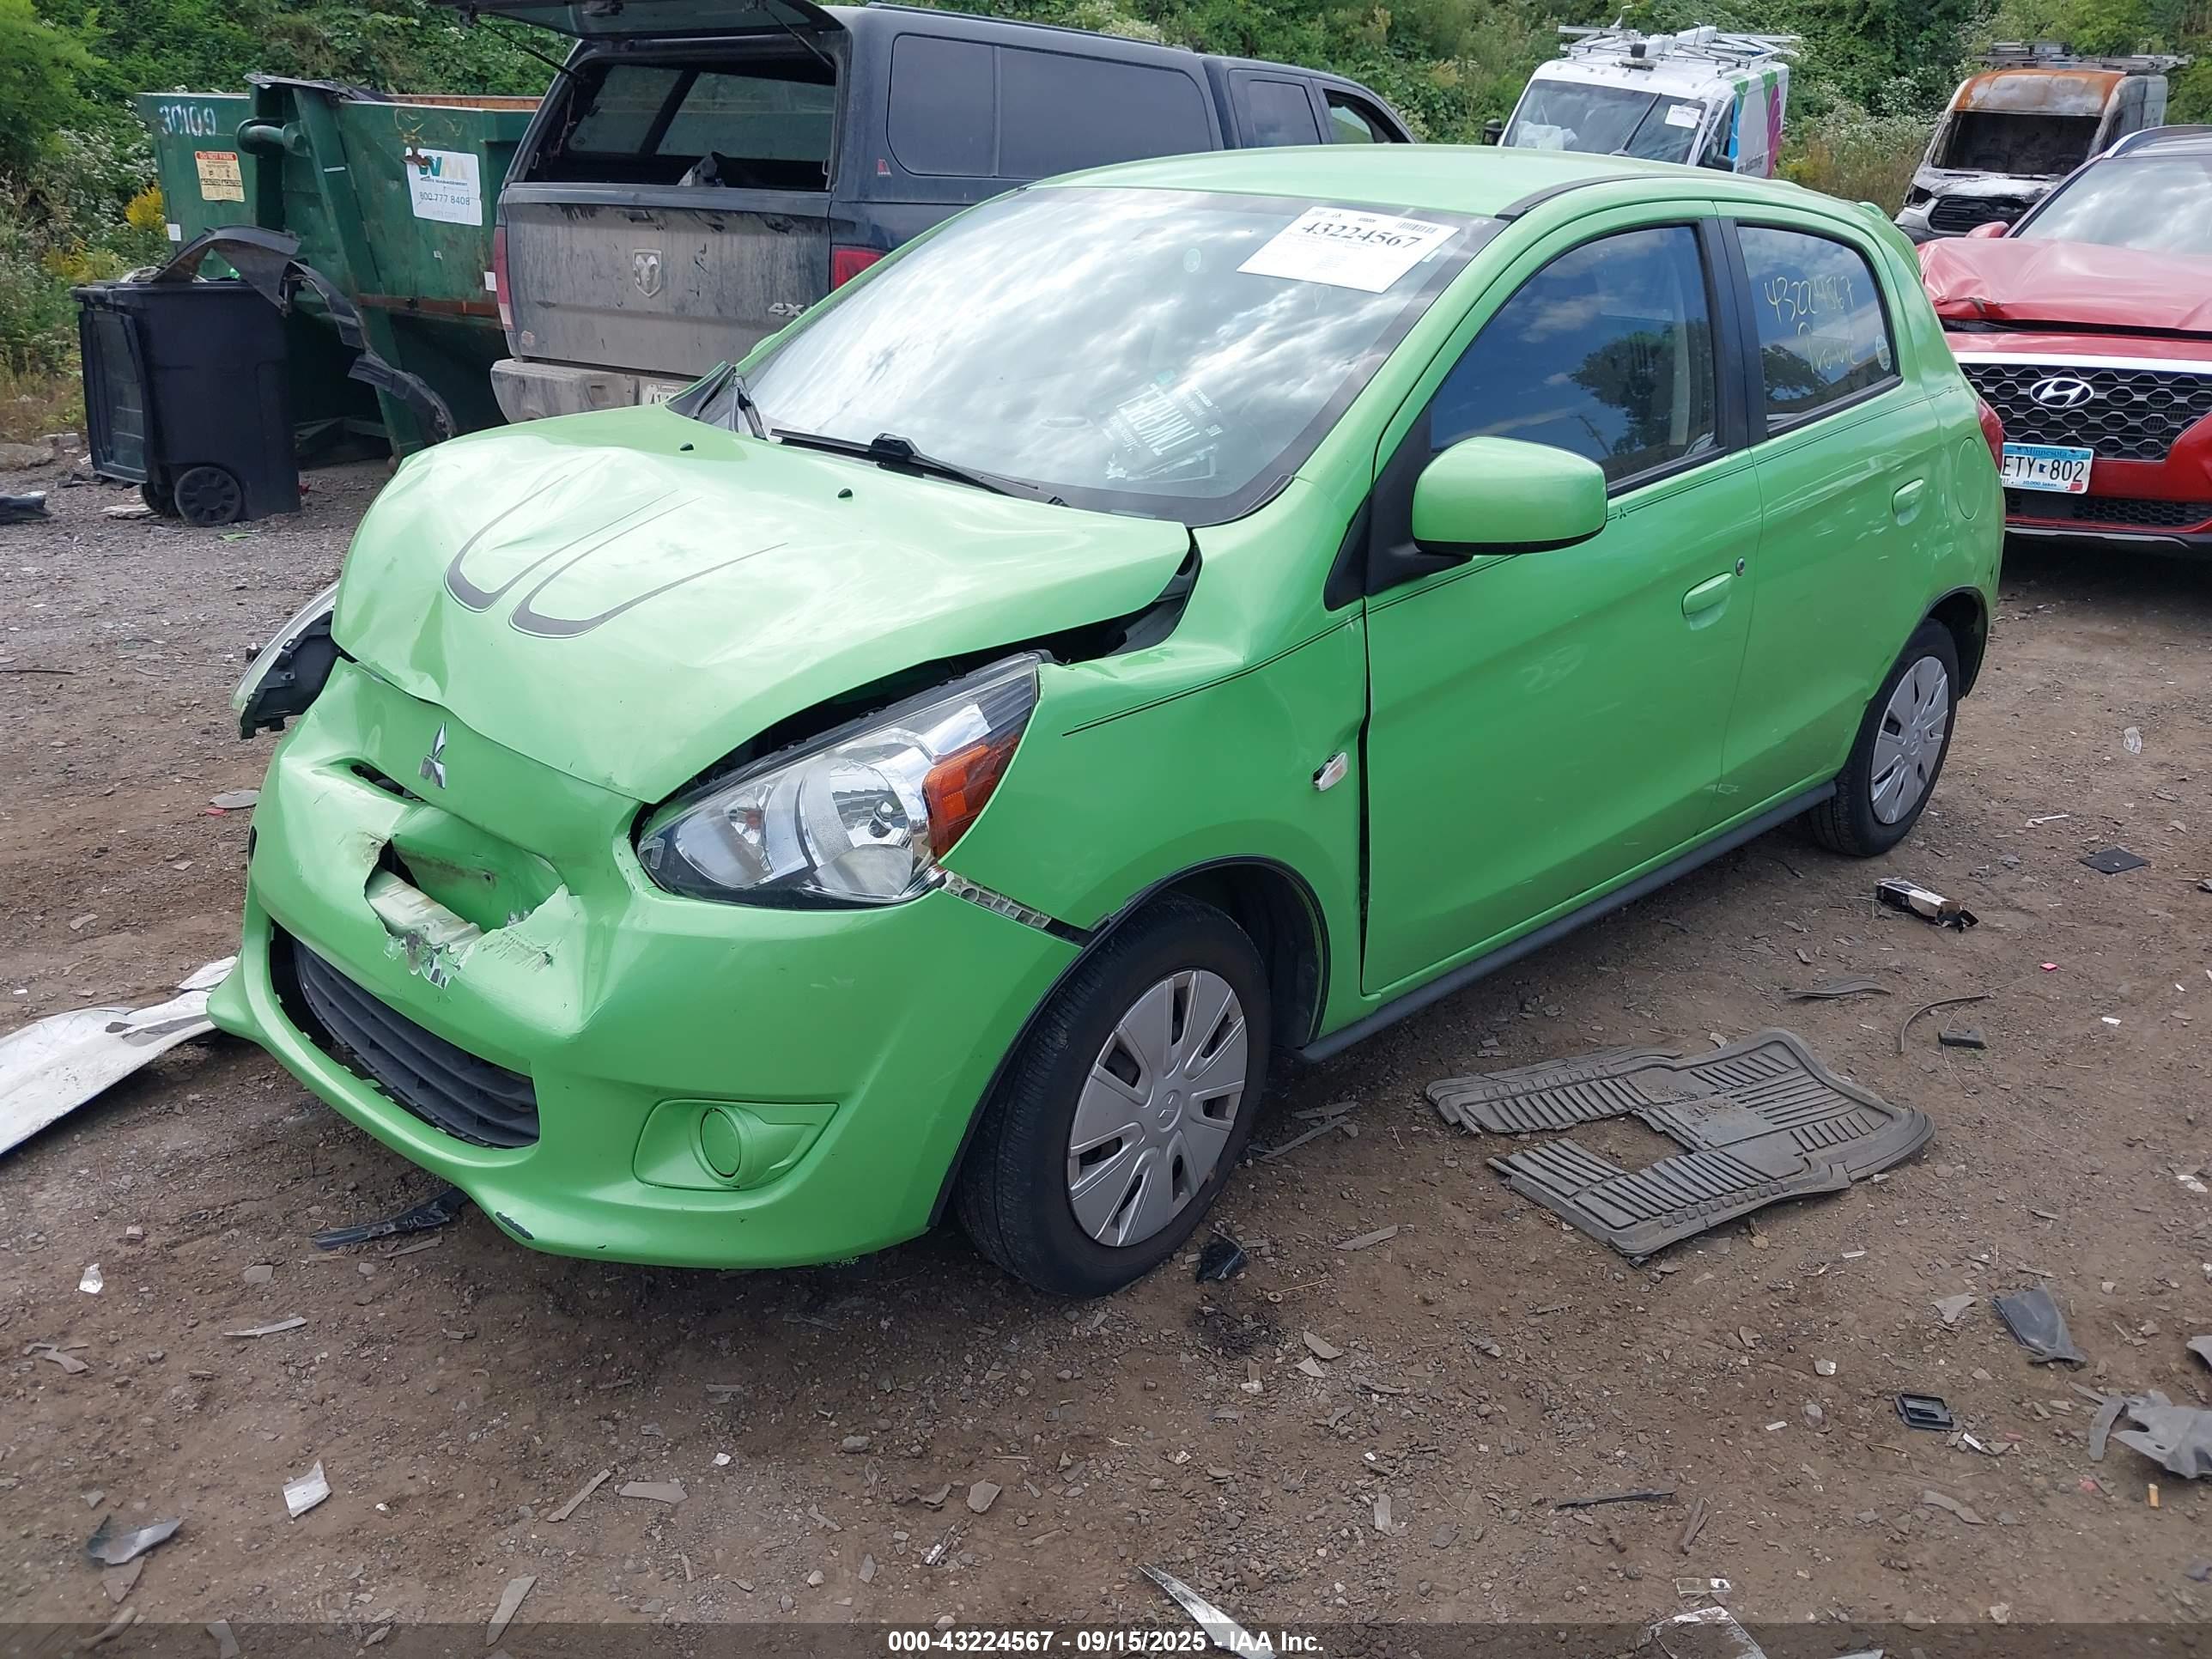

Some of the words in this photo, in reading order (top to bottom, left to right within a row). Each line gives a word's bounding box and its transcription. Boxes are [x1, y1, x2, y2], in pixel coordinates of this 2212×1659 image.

[1302, 222, 1423, 248] 43224567
[768, 302, 805, 317] 4X
[2024, 446, 2068, 458] Minnesota
[2002, 455, 2037, 478] ETY
[2049, 459, 2085, 483] 802
